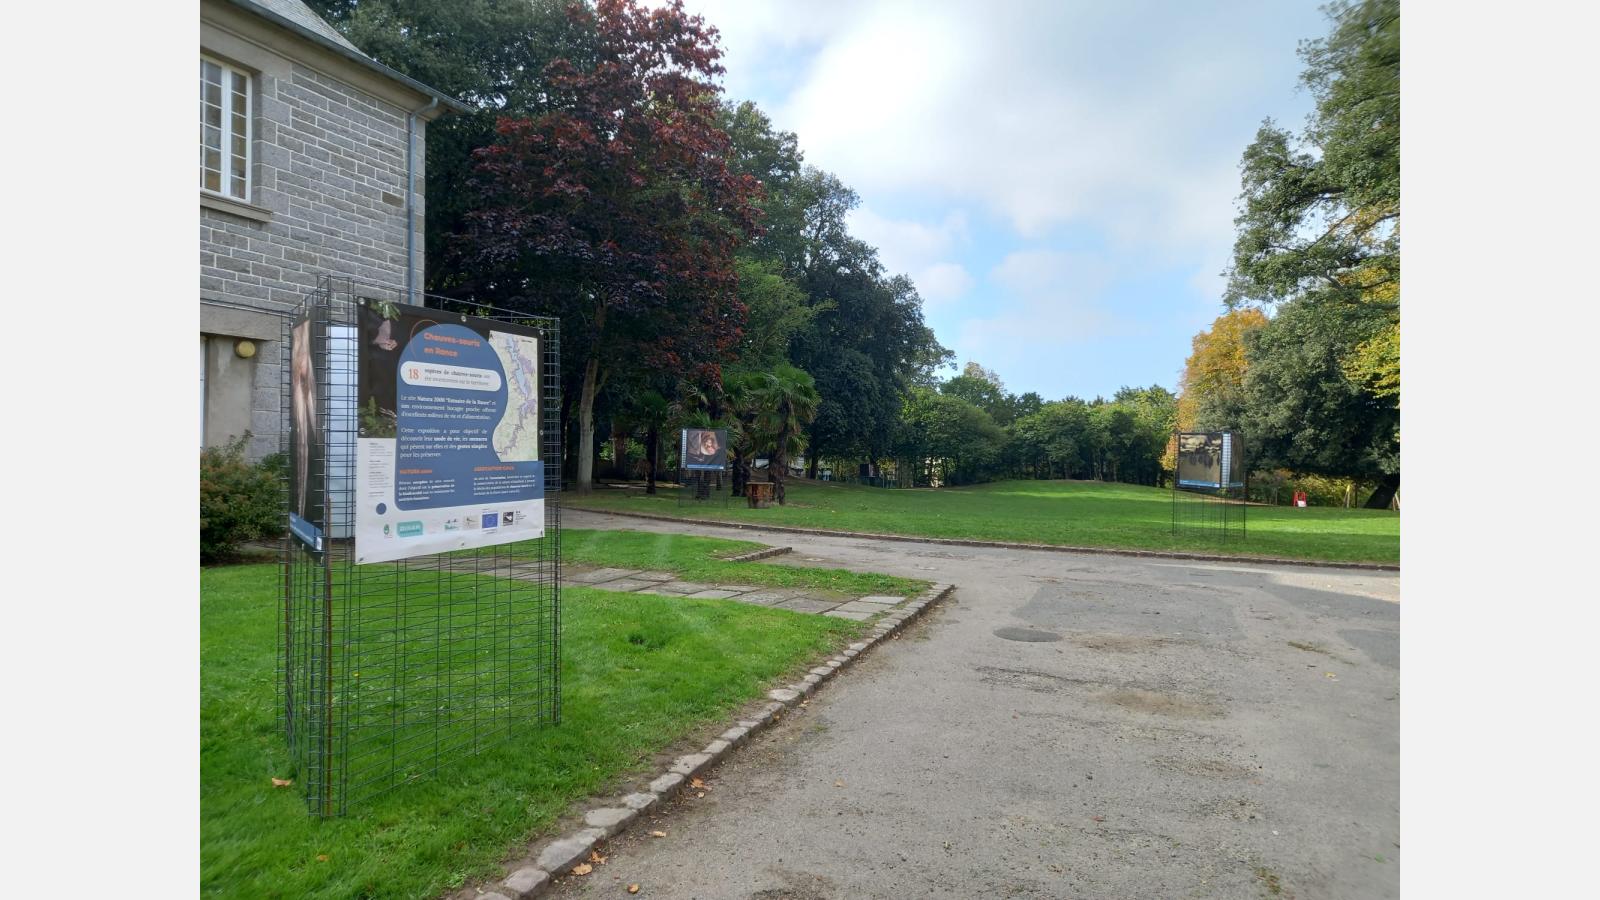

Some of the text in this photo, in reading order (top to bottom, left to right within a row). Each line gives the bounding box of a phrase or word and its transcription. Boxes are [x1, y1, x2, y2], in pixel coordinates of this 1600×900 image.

[424, 332, 480, 348] Chauves-souris
[434, 347, 458, 358] Rance
[409, 368, 420, 380] 18
